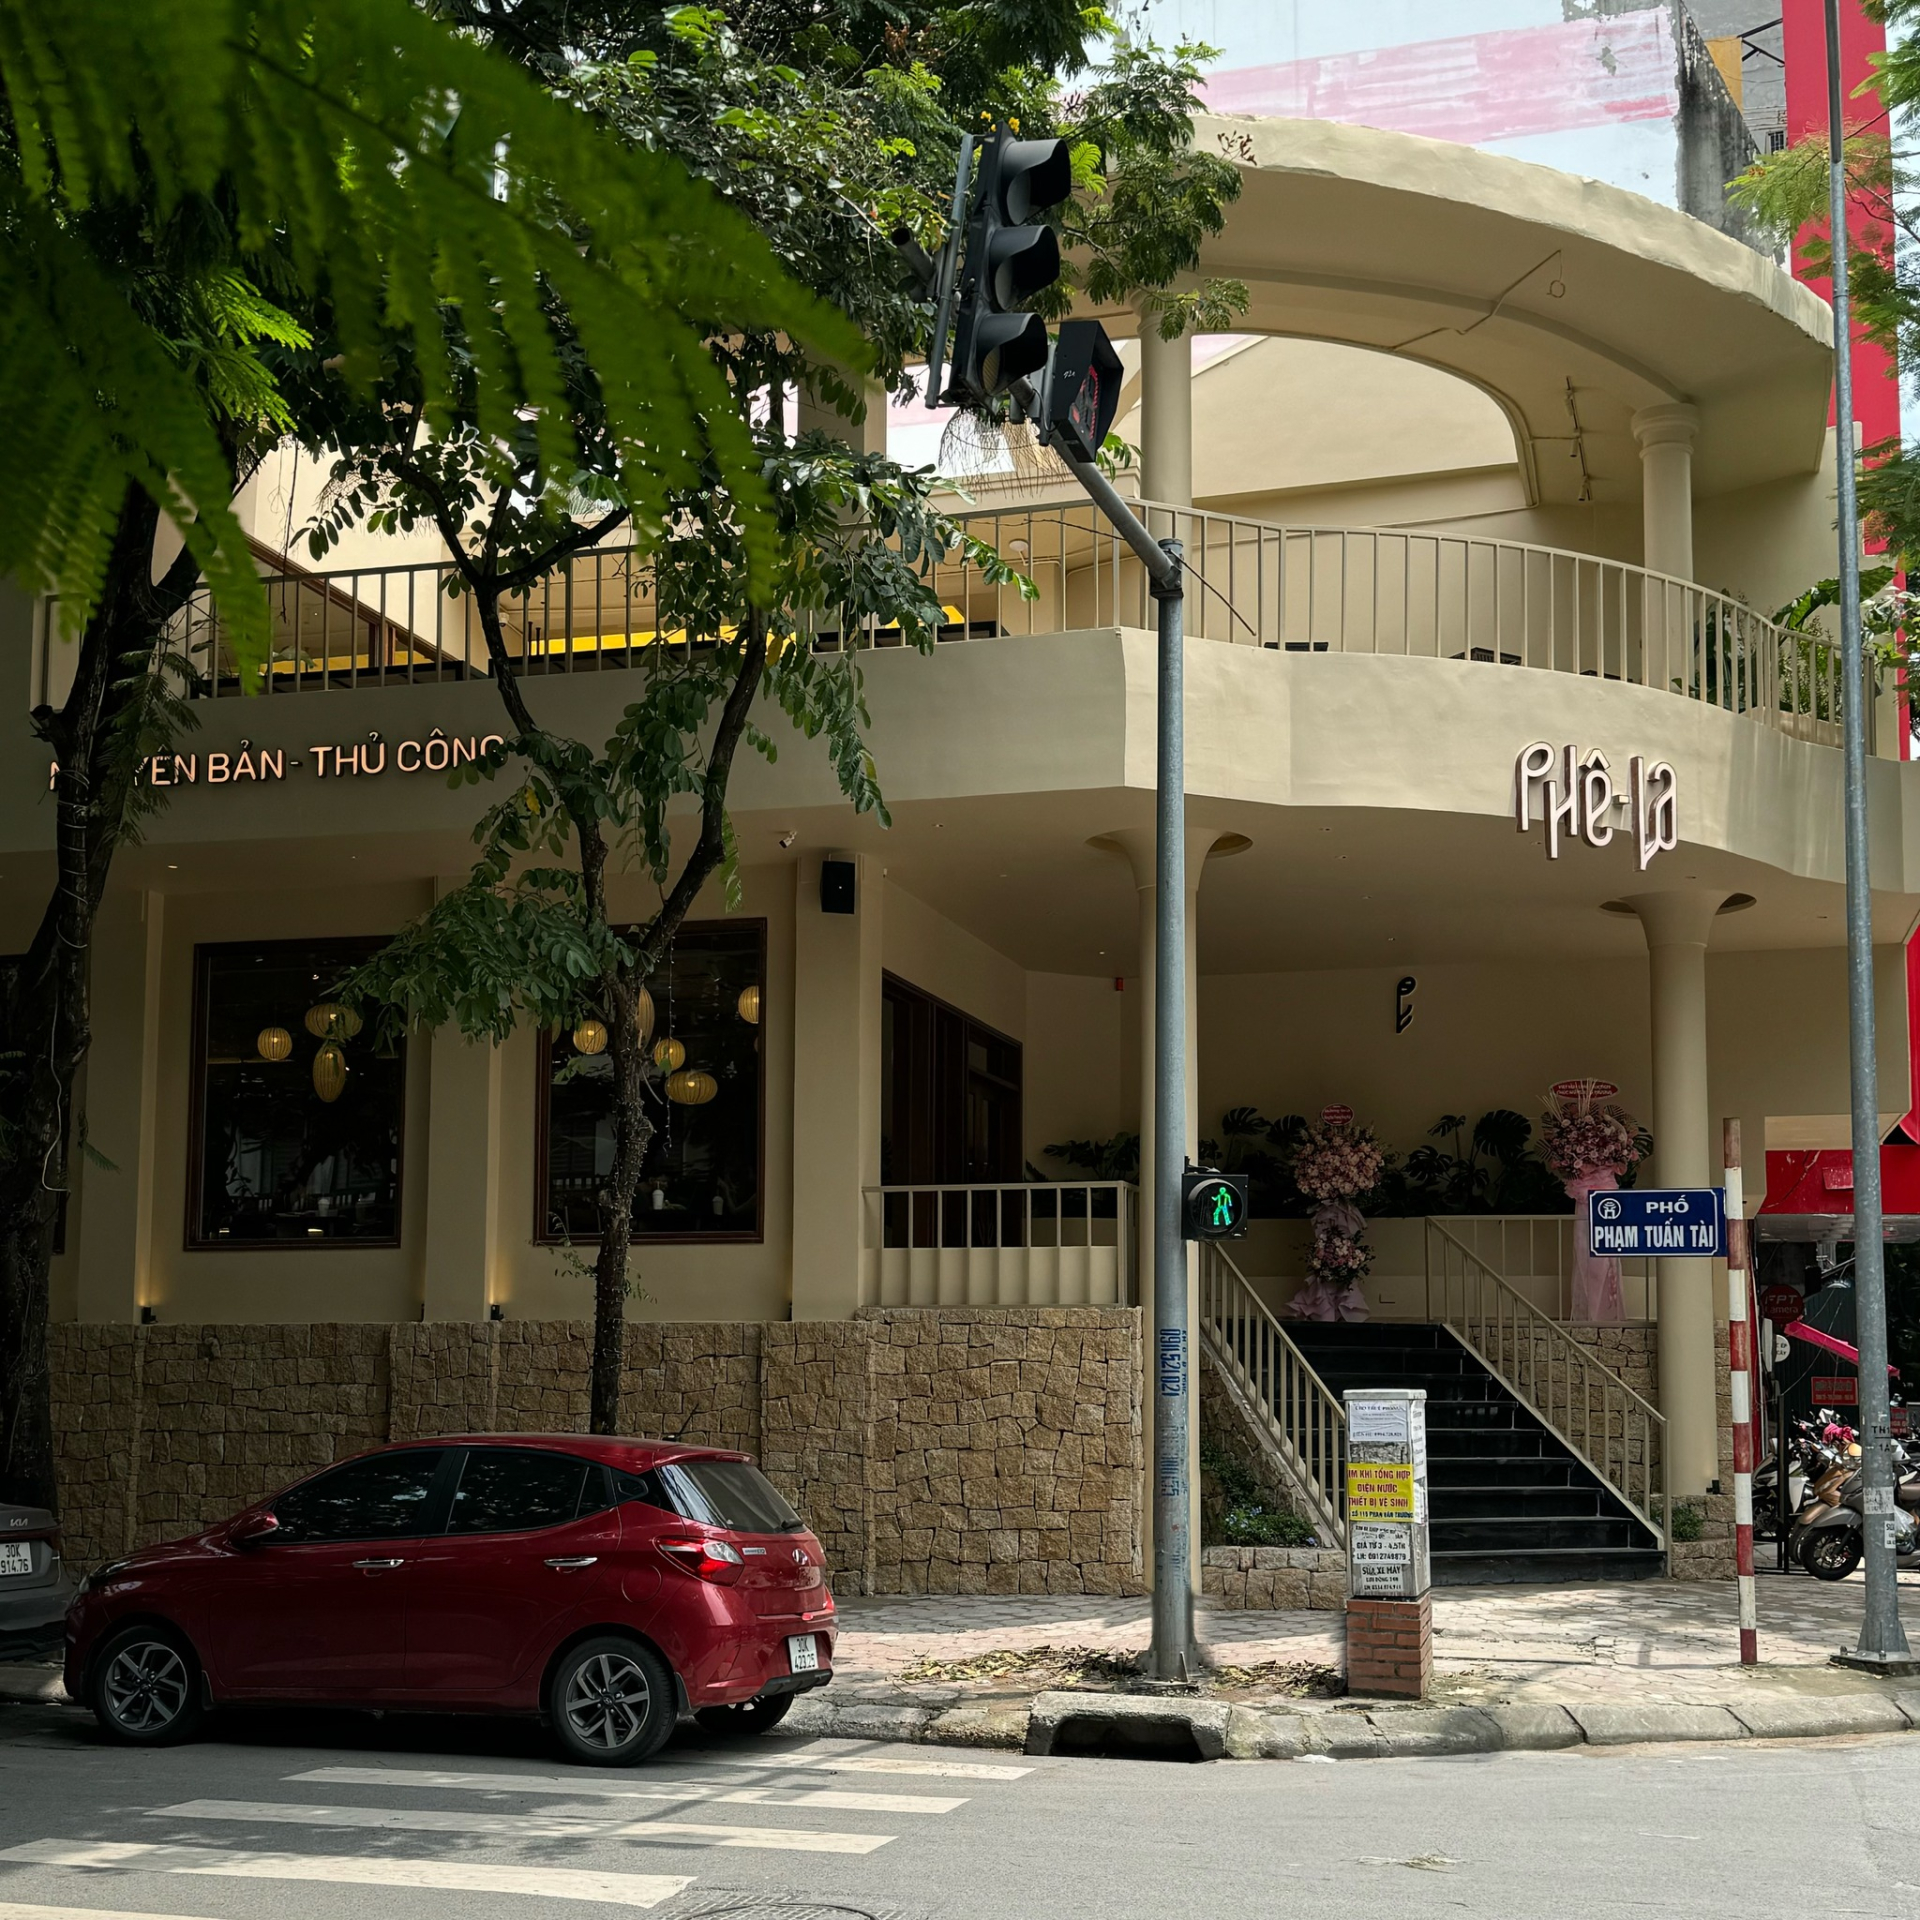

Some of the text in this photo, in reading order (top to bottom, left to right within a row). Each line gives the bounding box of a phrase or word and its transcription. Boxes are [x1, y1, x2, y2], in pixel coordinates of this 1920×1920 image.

[207, 739, 284, 783] BẢN
[309, 731, 385, 777] THỦ
[1645, 1195, 1690, 1214] PHỐ
[1594, 1217, 1714, 1252] PHẠM TUẤN TÀI
[1764, 1294, 1798, 1305] FPT
[1390, 1498, 1408, 1507] SINH
[10, 1518, 28, 1527] KIA
[5, 1544, 21, 1558] 30K
[1, 1558, 29, 1574] 914.76
